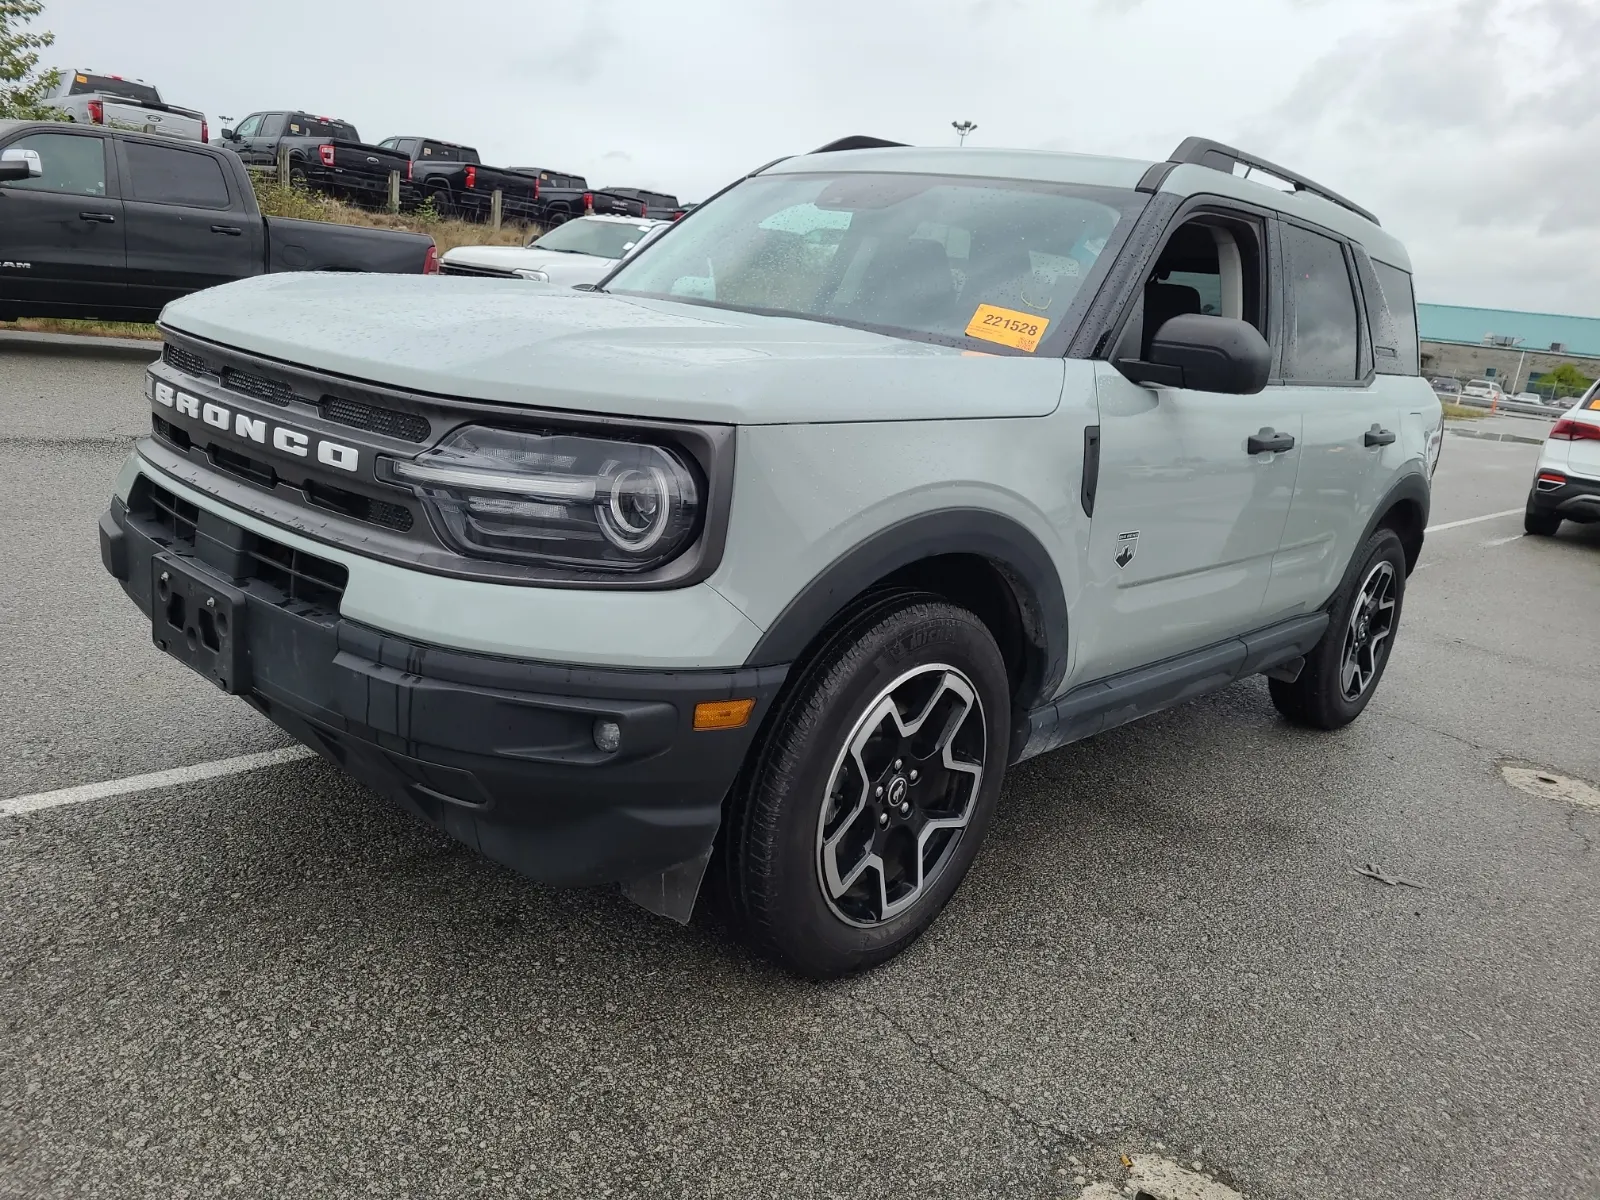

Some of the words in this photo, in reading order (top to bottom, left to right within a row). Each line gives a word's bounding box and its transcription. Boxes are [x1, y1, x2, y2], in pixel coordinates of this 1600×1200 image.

[0, 261, 31, 269] AM
[983, 314, 1038, 336] 221528
[155, 381, 359, 472] BRONCO
